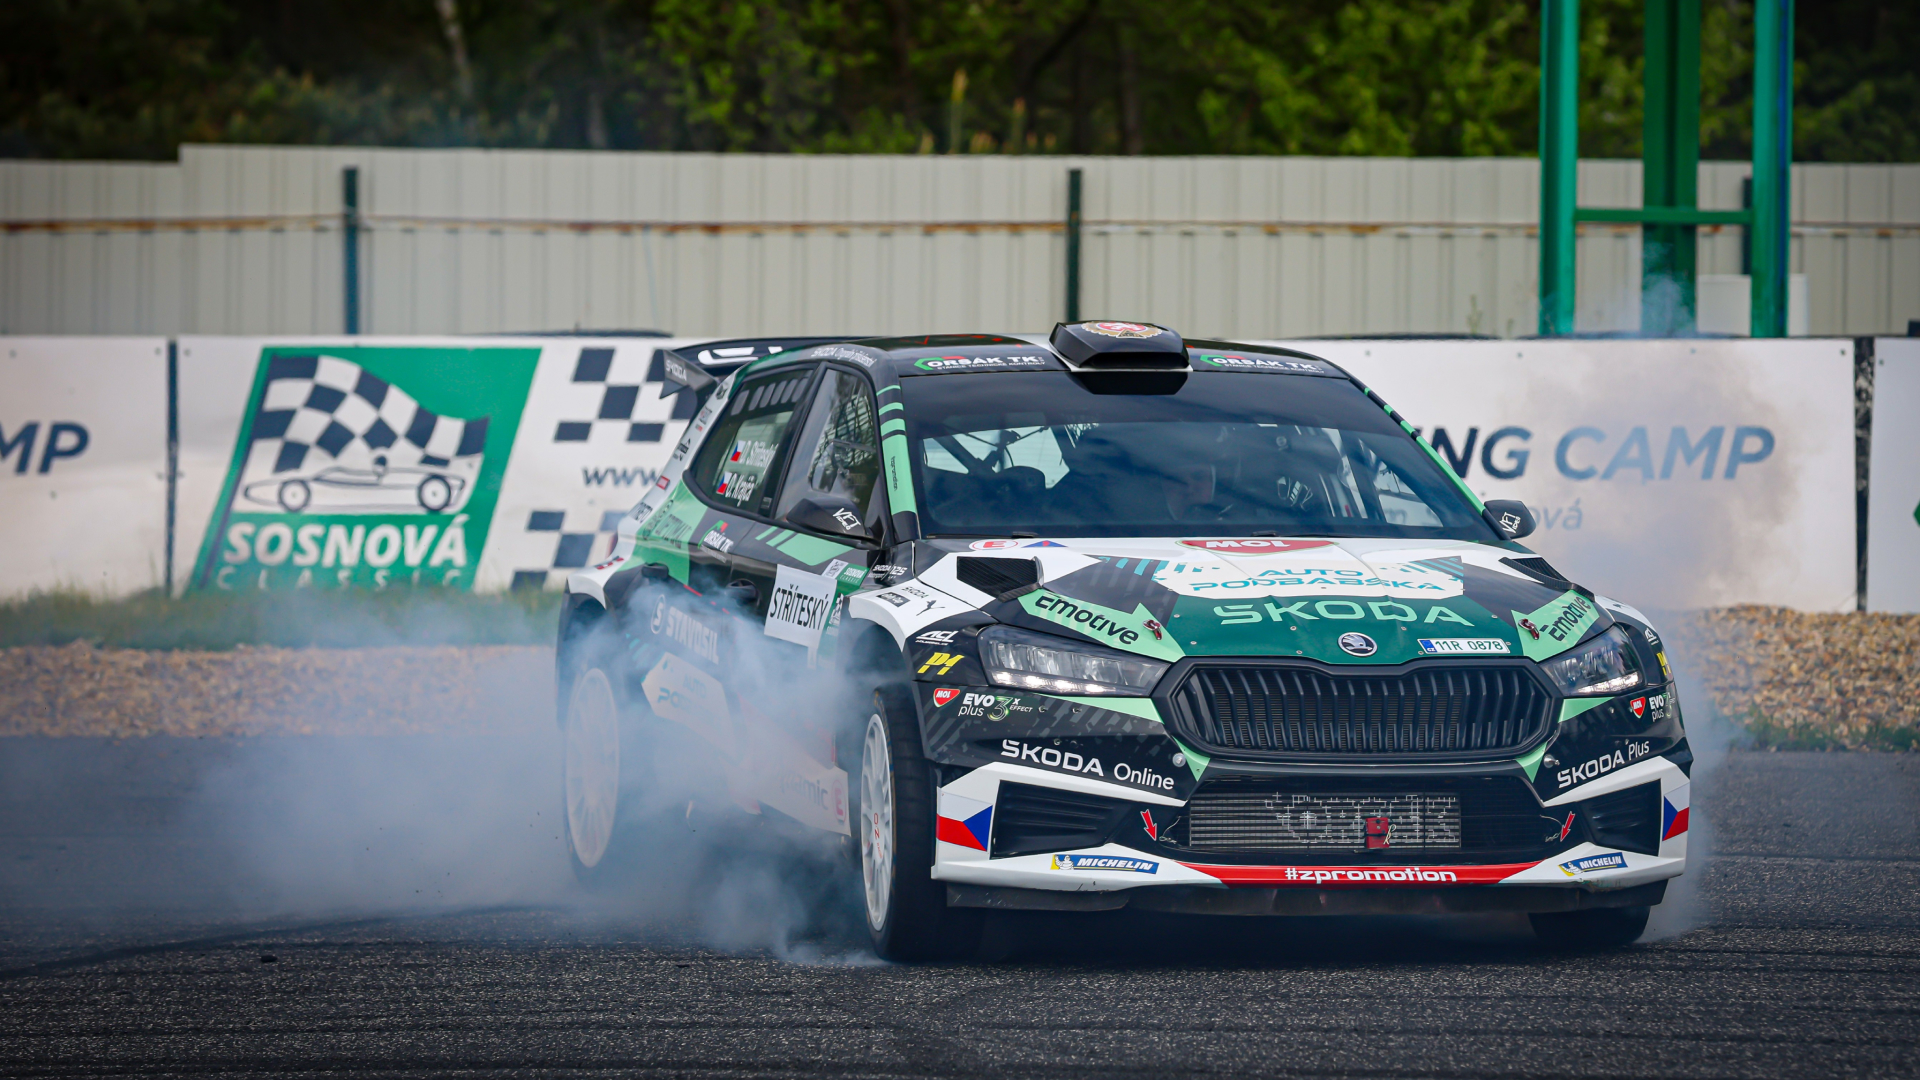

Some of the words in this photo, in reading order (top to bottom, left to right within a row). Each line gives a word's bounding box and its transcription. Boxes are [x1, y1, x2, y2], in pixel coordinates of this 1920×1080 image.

[1007, 355, 1039, 363] TK
[1285, 362, 1317, 370] TK
[1555, 425, 1775, 481] CAMP
[223, 513, 470, 568] SOSNOVÁ
[1206, 540, 1291, 549] MOL
[889, 565, 908, 575] 125
[1259, 568, 1363, 577] AUTO
[1189, 577, 1446, 591] PODBABSKA
[769, 583, 829, 630] STŘÍTESKÝ
[1434, 640, 1464, 651] 11R
[1467, 640, 1504, 651] 0878
[936, 690, 952, 699] MOL
[963, 692, 995, 707] EVO
[1648, 694, 1664, 710] EVO
[957, 702, 985, 717] plus
[1009, 705, 1034, 713] EFFECT
[1651, 707, 1665, 722] plus
[1628, 740, 1650, 762] Plus
[1113, 762, 1175, 790] Online
[1076, 857, 1153, 870] MICHELIN
[1579, 855, 1622, 870] MICHELIN
[1285, 867, 1457, 884] #zpromotion
